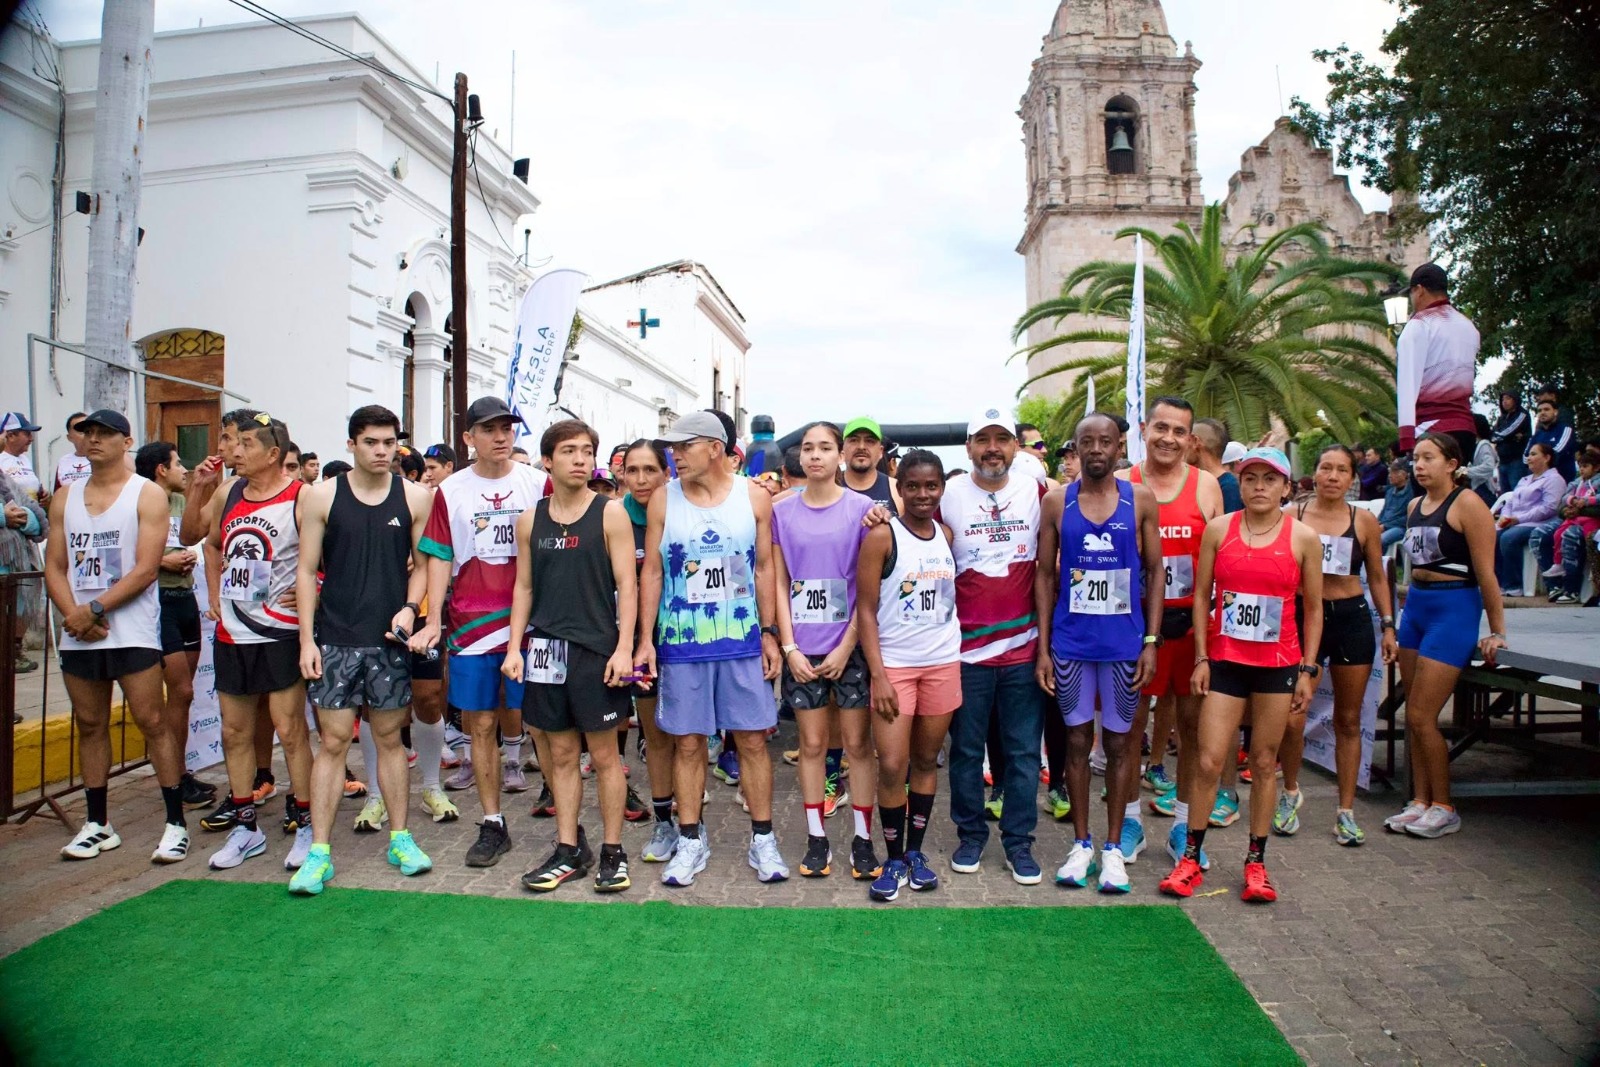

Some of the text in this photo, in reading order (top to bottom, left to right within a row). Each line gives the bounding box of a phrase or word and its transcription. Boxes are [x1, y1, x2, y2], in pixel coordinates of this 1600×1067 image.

[519, 327, 550, 404] VIZSLA
[530, 369, 546, 407] SILVER
[225, 516, 279, 538] DEPORTIVO
[493, 524, 515, 545] 203
[964, 529, 983, 537] SAN
[988, 532, 1011, 543] 2026
[1158, 525, 1192, 539] XICO
[70, 530, 120, 548] 247 RUNNING
[1078, 555, 1119, 564] THE SWAN
[231, 567, 250, 588] 049
[704, 566, 726, 590] 201
[806, 589, 827, 610] 205
[919, 589, 936, 612] 167
[1087, 579, 1109, 602] 210
[1236, 603, 1261, 628] 360
[533, 647, 550, 670] 202
[199, 716, 218, 727] VIZSLA
[603, 711, 618, 722] NASA
